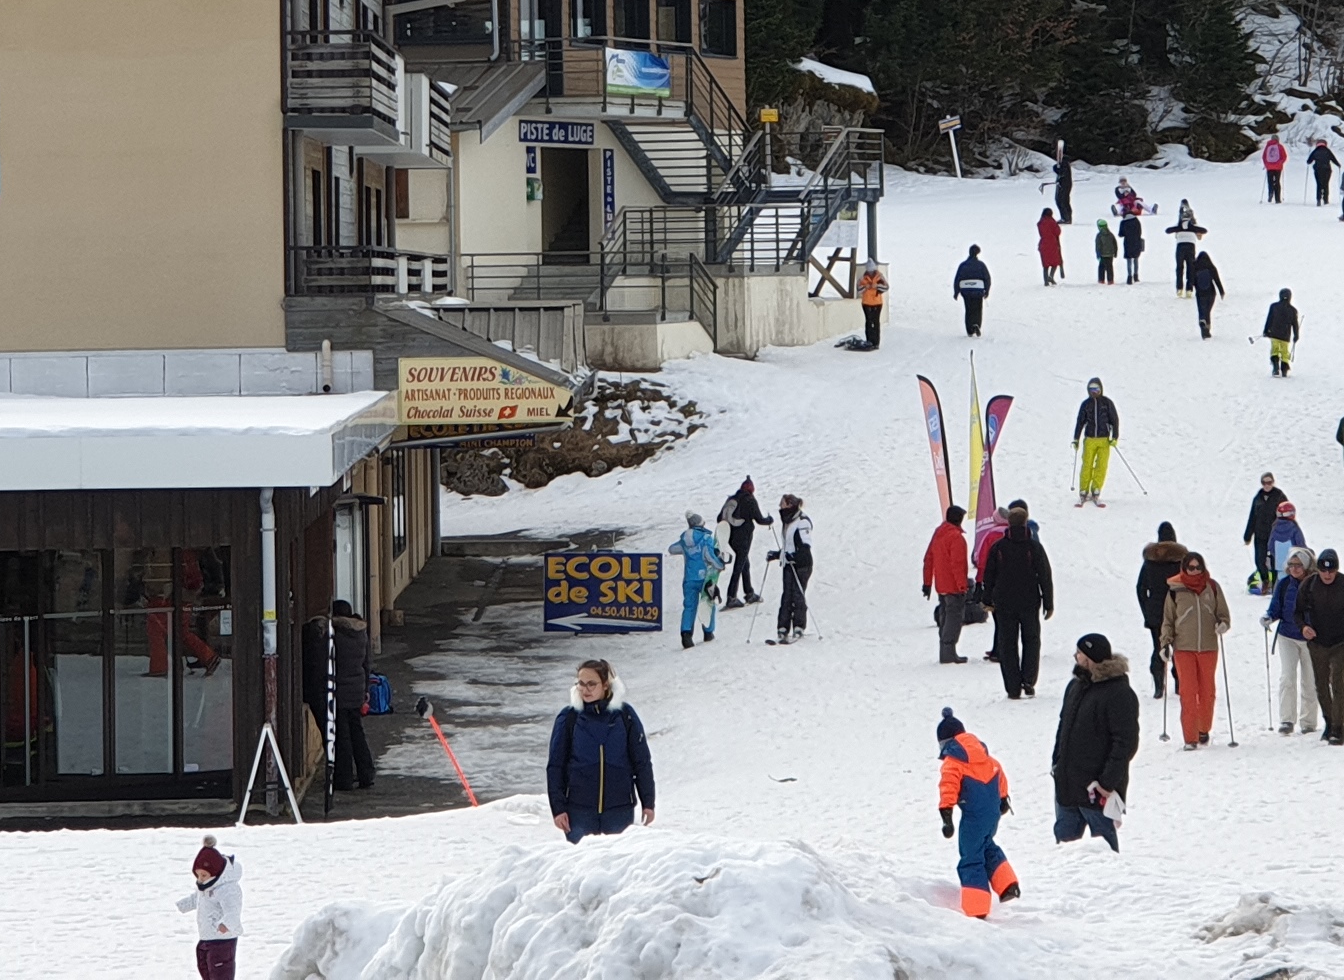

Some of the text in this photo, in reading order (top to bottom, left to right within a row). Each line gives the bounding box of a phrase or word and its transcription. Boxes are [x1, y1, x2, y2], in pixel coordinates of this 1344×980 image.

[520, 122, 594, 142] PISTE de LUGE
[406, 366, 498, 383] SOUVENIRS
[404, 386, 556, 402] ARTISANAT PRODUITS REGIONAUX
[406, 404, 551, 420] Chocolat Suisse MIEL
[484, 437, 534, 447] CHAMPION
[547, 556, 660, 580] ECOLE
[547, 580, 654, 604] de SKI
[590, 606, 659, 620] 04.50.41.30.29
